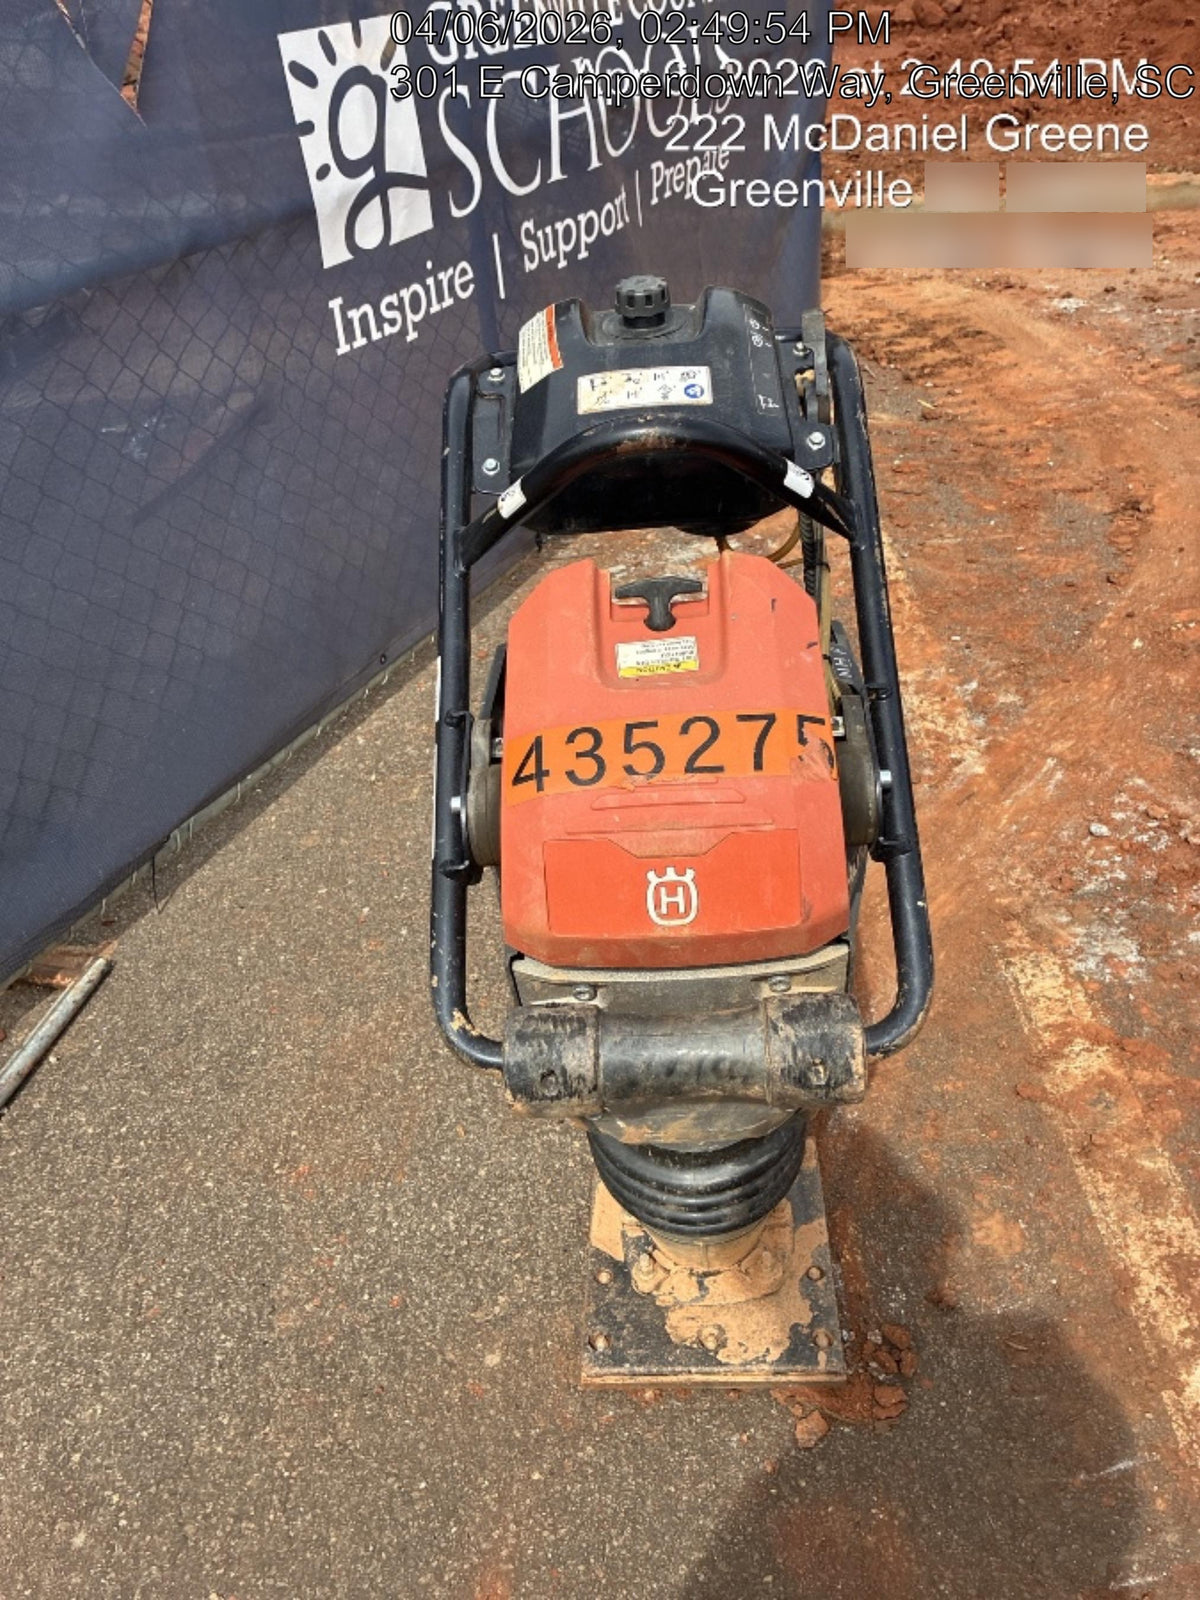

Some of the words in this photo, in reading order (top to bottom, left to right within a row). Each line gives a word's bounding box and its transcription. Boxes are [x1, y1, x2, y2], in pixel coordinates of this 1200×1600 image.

[329, 260, 475, 356] Inspire
[520, 183, 630, 273] Support
[650, 147, 730, 206] Prepare
[511, 713, 836, 793] 435275
